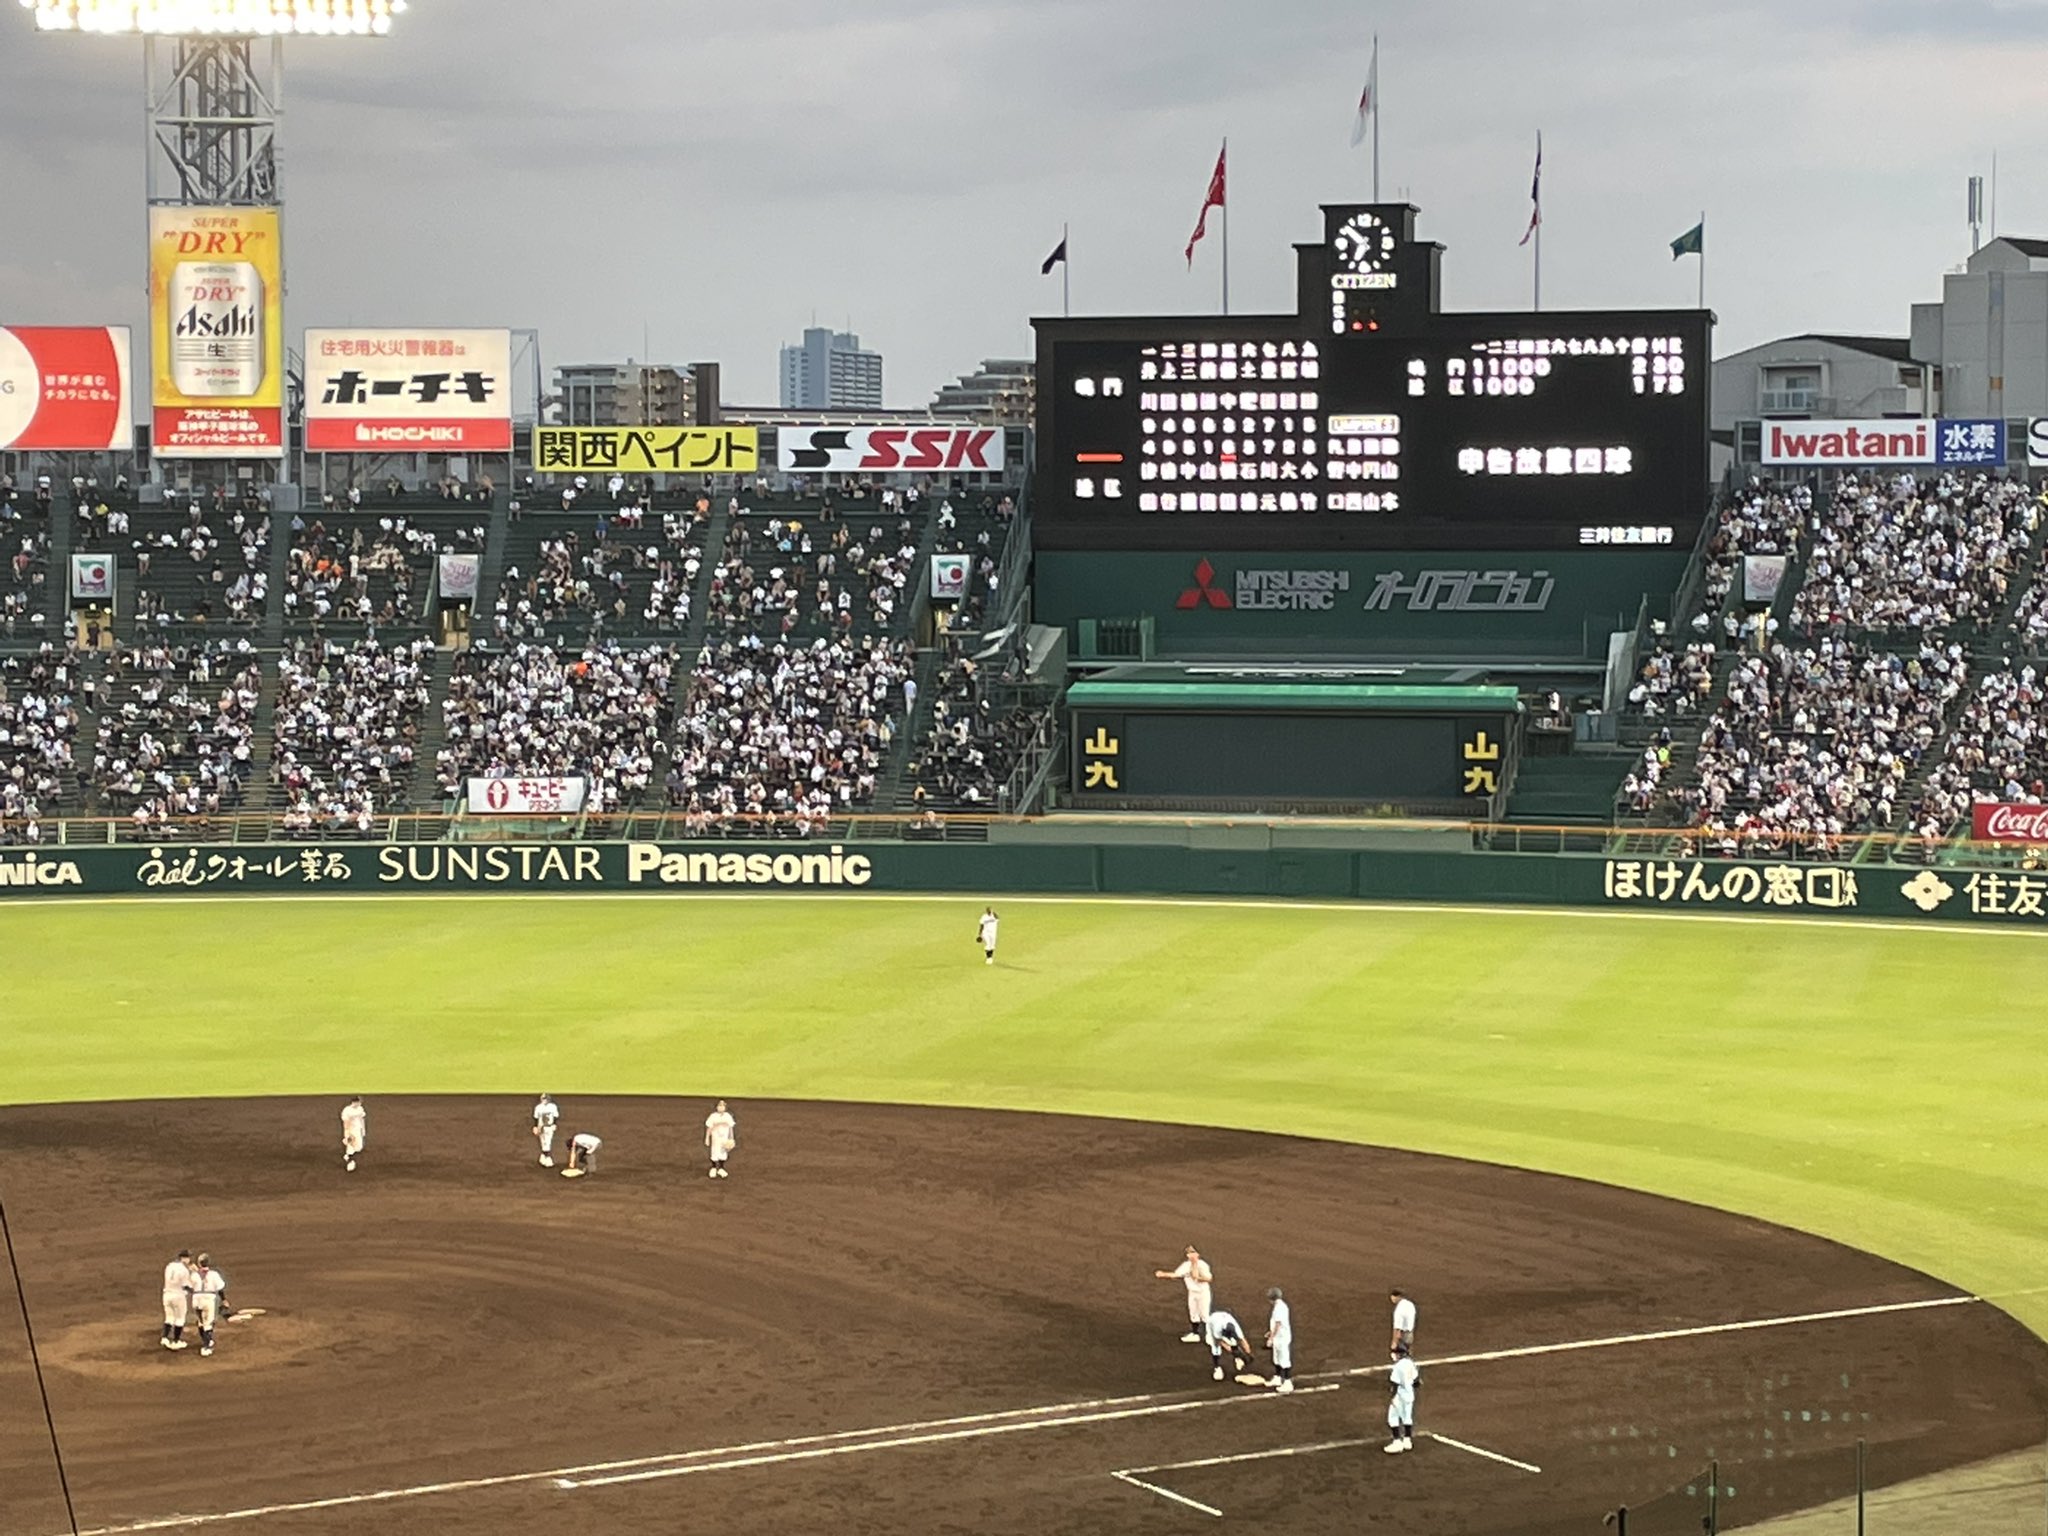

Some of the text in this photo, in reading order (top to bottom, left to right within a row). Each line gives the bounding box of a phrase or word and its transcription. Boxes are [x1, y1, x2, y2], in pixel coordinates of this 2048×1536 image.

[192, 217, 238, 227] SUPER
[1331, 273, 1396, 290] CITIZEN
[176, 303, 255, 336] Asahi
[321, 371, 495, 403] ホーチキ
[372, 427, 463, 441] HOCHIKI
[538, 431, 755, 468] 関西ペイント
[858, 430, 996, 468] SSK
[1771, 425, 1927, 457] Iwatani
[1944, 424, 1996, 449] 水素
[1943, 451, 1996, 462] エネルギー
[1236, 570, 1349, 590] MITSUBISHI
[1236, 591, 1334, 610] ELECTRIC
[1085, 727, 1118, 789] 山九
[1464, 731, 1498, 794] 山九
[378, 846, 603, 882] SUNSTAR
[628, 844, 872, 885] Panasonic
[1605, 860, 1839, 906] ほけんの窓口
